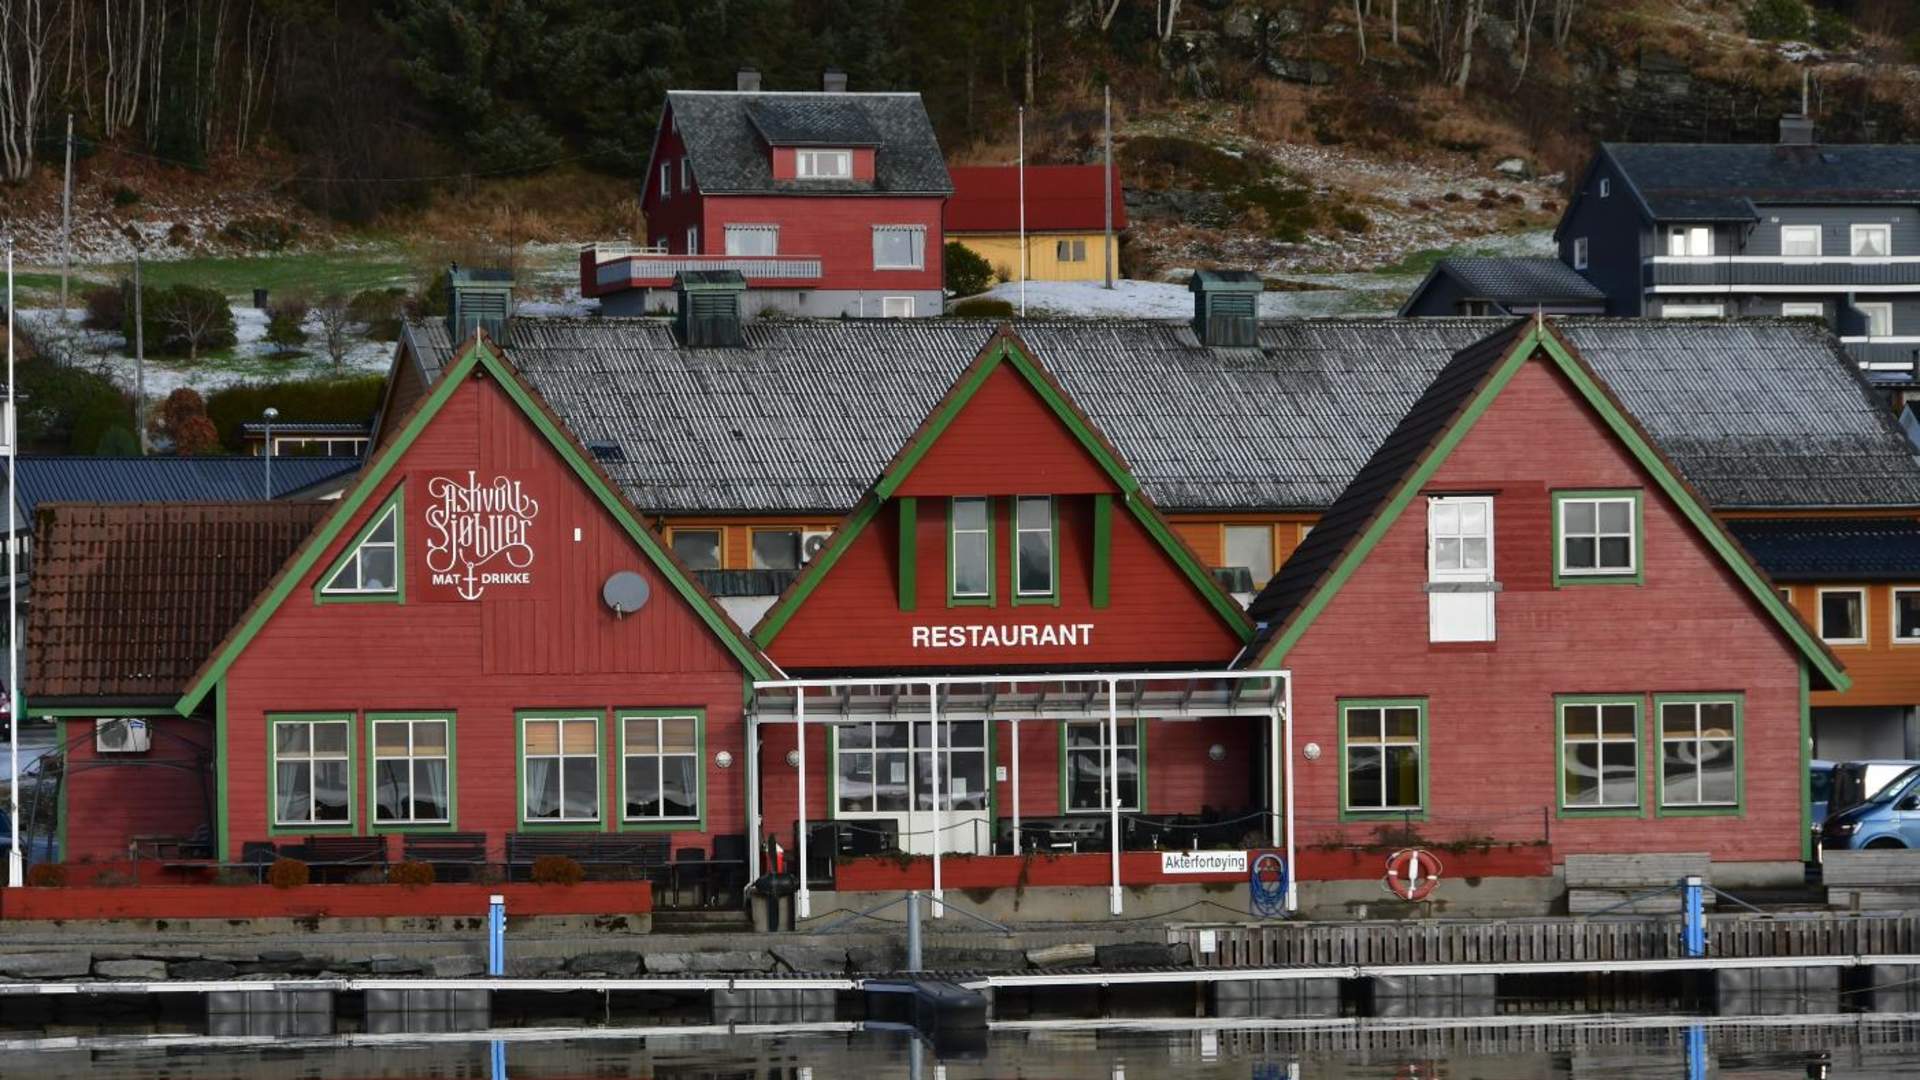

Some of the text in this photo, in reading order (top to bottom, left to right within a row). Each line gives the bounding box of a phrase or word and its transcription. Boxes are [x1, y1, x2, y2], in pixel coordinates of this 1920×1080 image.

[425, 504, 534, 572] Sjøbuer
[432, 573, 530, 585] MAT DRIKKE
[912, 624, 1094, 647] RESTAURANT
[1165, 855, 1245, 871] Akterfortøying
